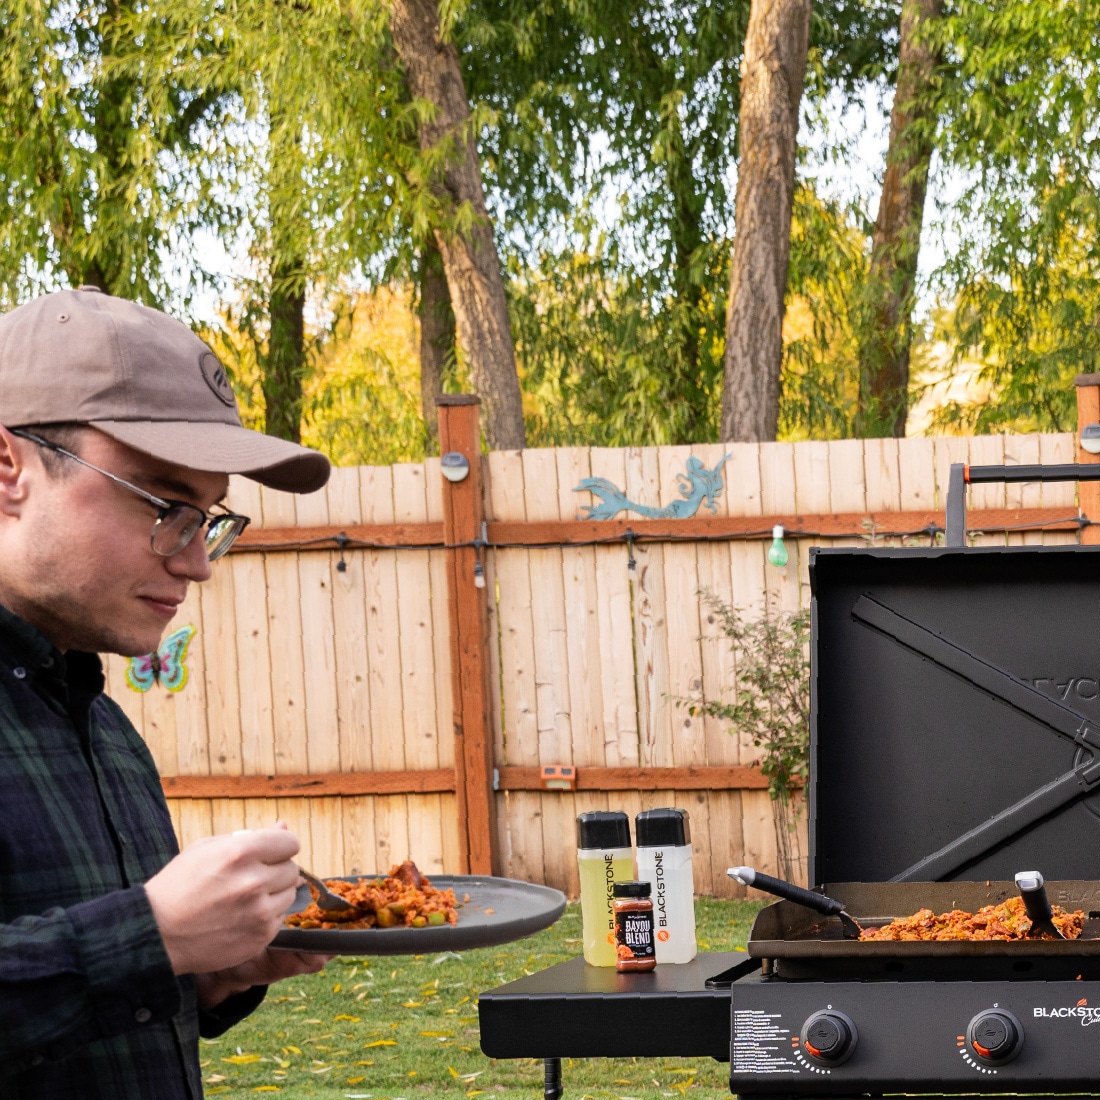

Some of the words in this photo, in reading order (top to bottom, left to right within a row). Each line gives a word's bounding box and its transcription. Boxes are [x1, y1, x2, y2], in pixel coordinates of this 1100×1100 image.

[655, 851, 667, 927] BLACKSTONE
[625, 920, 651, 933] BAYOU
[625, 932, 651, 945] BLEND
